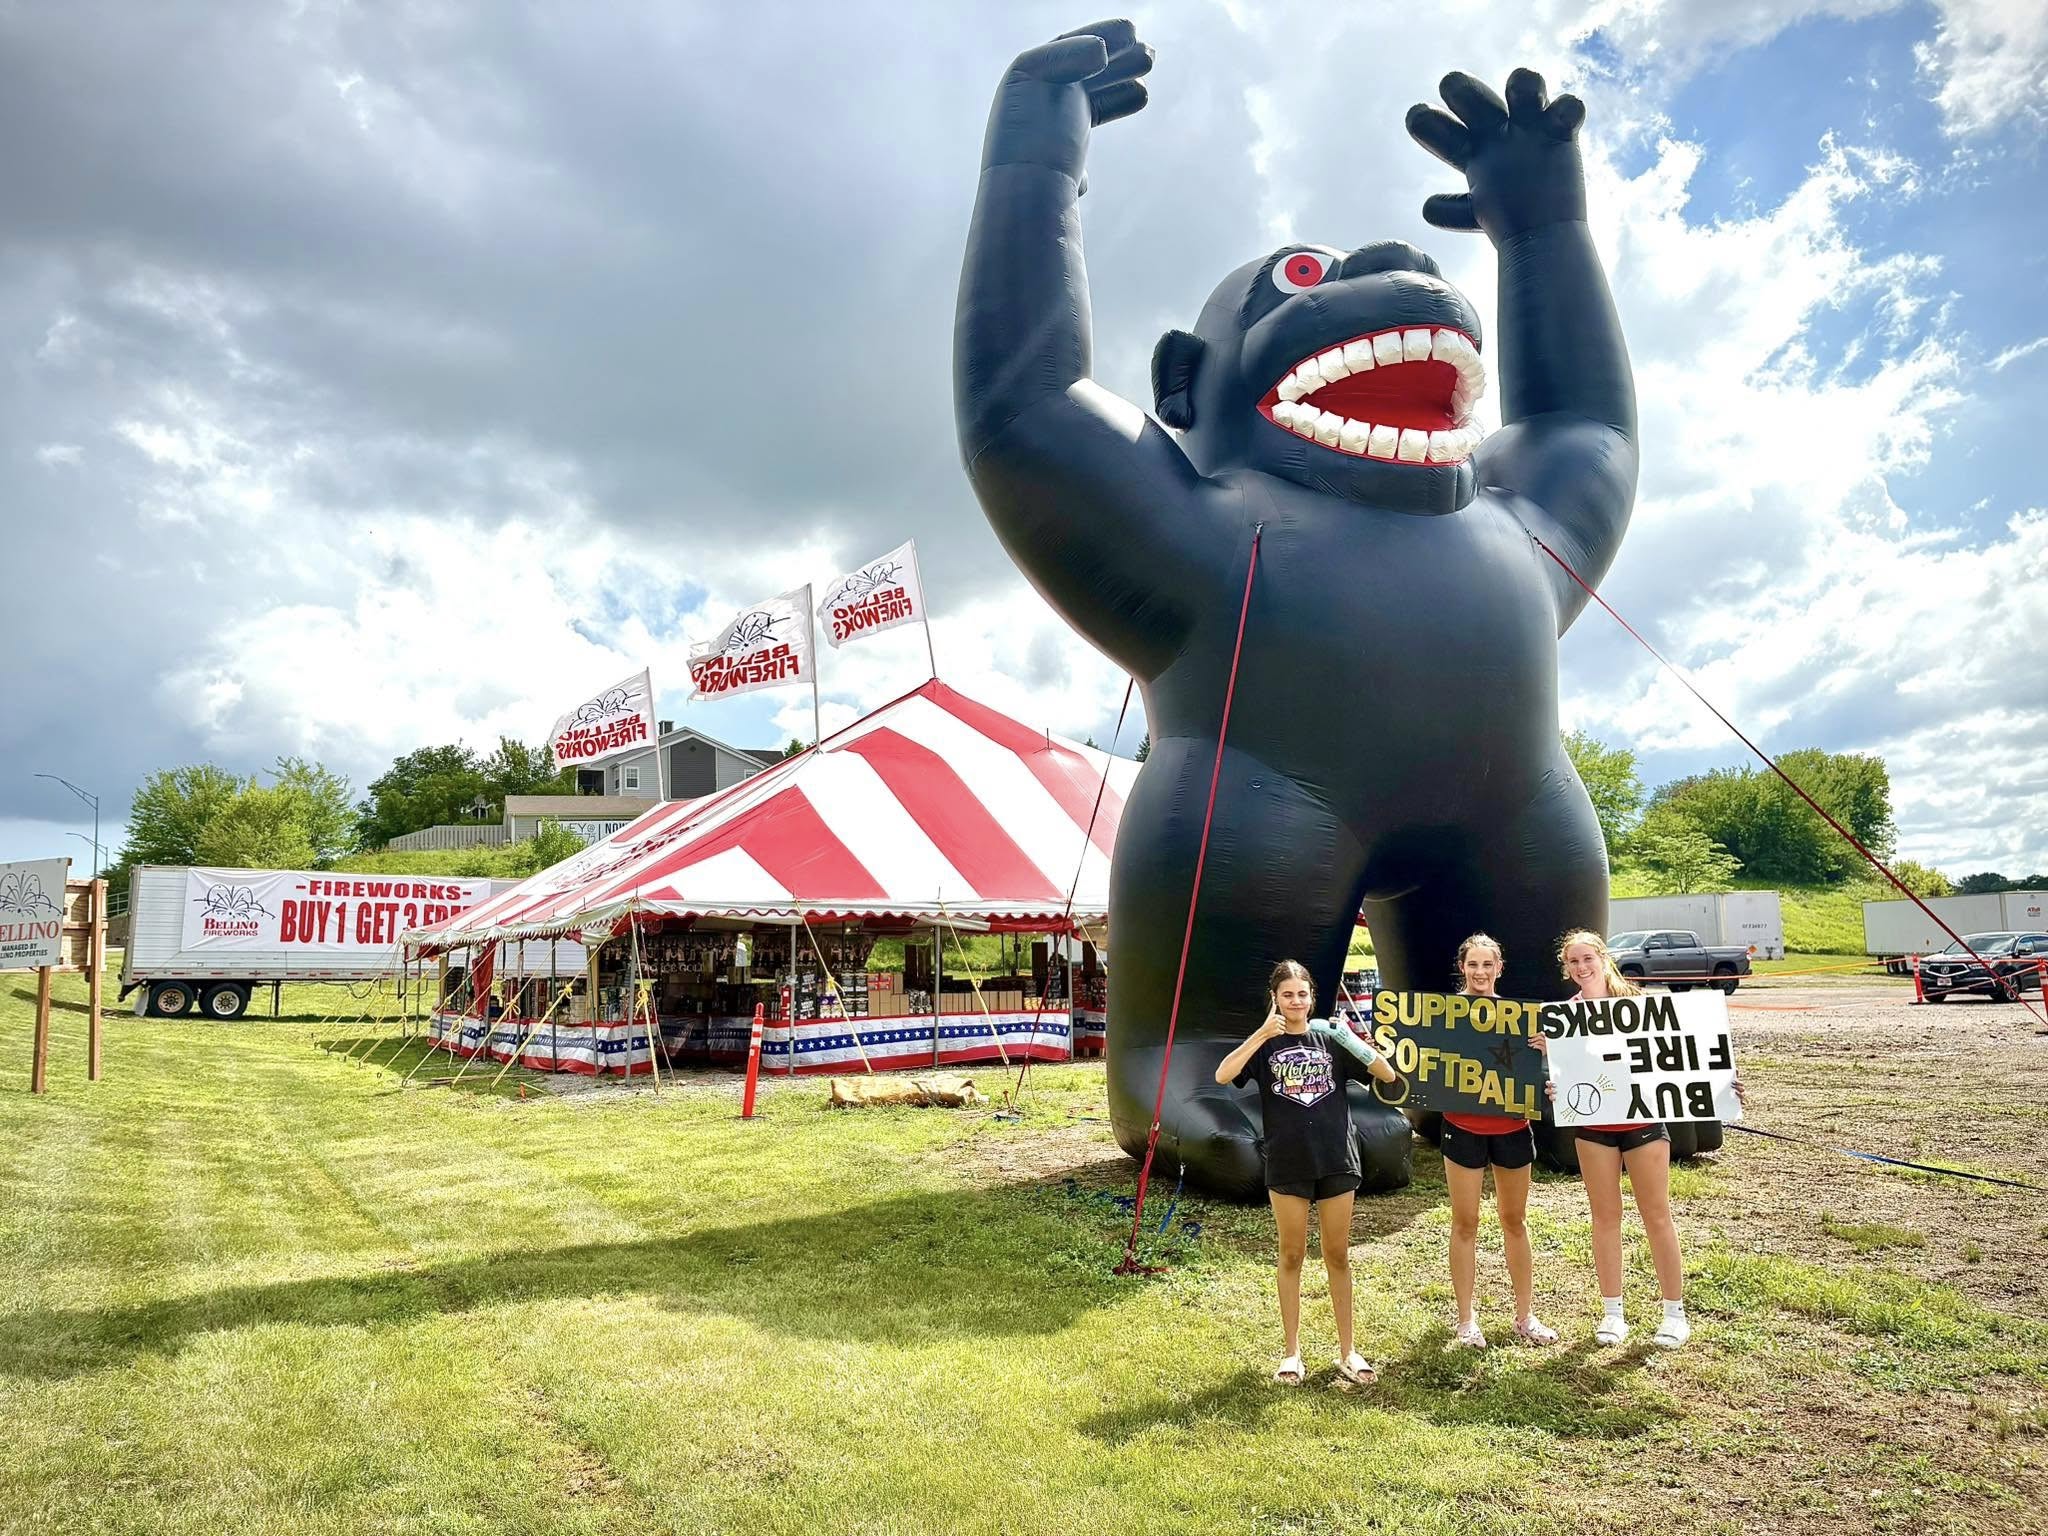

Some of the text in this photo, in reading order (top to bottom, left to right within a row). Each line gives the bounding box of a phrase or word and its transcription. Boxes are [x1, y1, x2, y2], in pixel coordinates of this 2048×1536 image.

[0, 921, 59, 942] ELLINO
[203, 929, 258, 937] FIREWORKS
[204, 918, 258, 930] BELLINO
[280, 900, 331, 943] BUY
[336, 902, 347, 944] 1
[356, 902, 400, 945] GET
[403, 903, 417, 930] 3
[0, 949, 48, 959] LINO PROPERTIES
[1, 943, 29, 951] MANAGED
[1373, 990, 1541, 1037] SUPPORT
[1540, 996, 1681, 1040] WORKS
[1374, 1025, 1542, 1121] SOFTBALL
[1626, 1081, 1716, 1119] BUY
